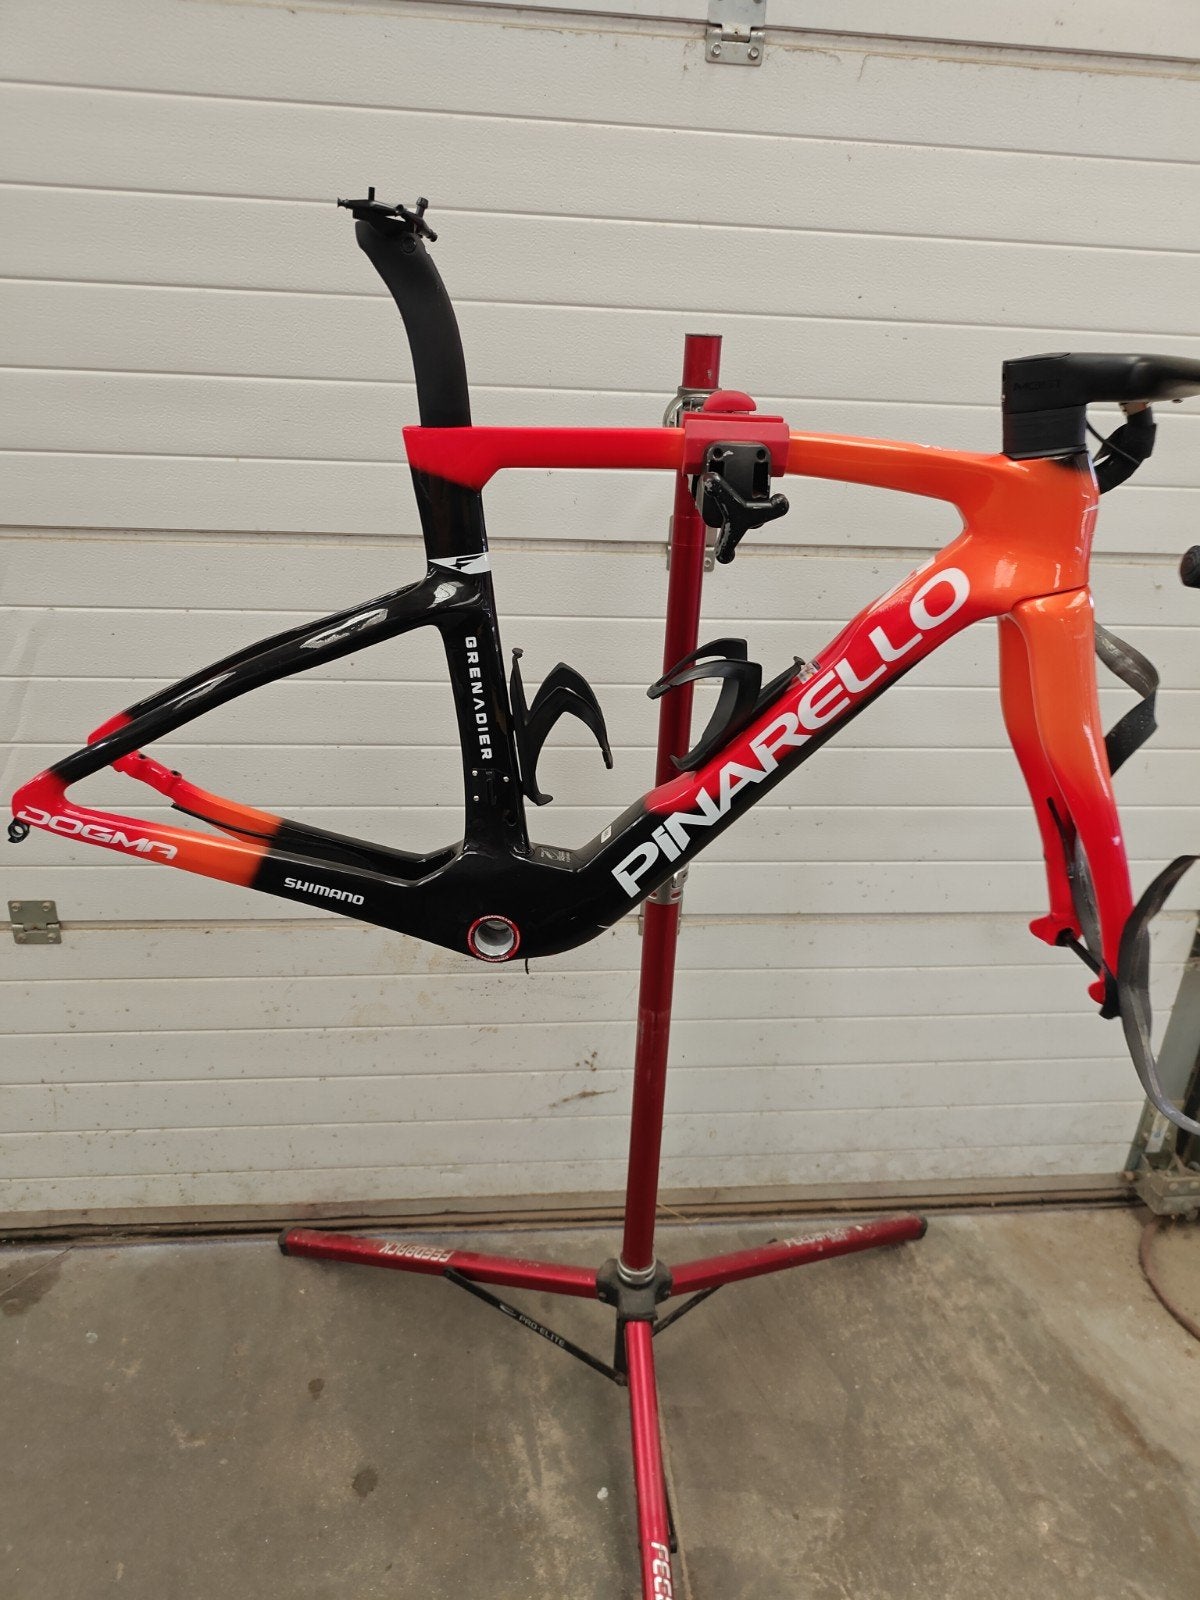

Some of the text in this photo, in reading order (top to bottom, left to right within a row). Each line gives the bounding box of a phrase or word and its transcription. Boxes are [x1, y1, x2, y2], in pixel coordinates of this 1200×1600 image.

[465, 636, 493, 760] GRENADIER
[611, 567, 971, 898] PINARELLO
[16, 804, 178, 860] DOGMA
[283, 877, 365, 906] SHIMANO
[378, 1242, 456, 1263] FEEDBACK
